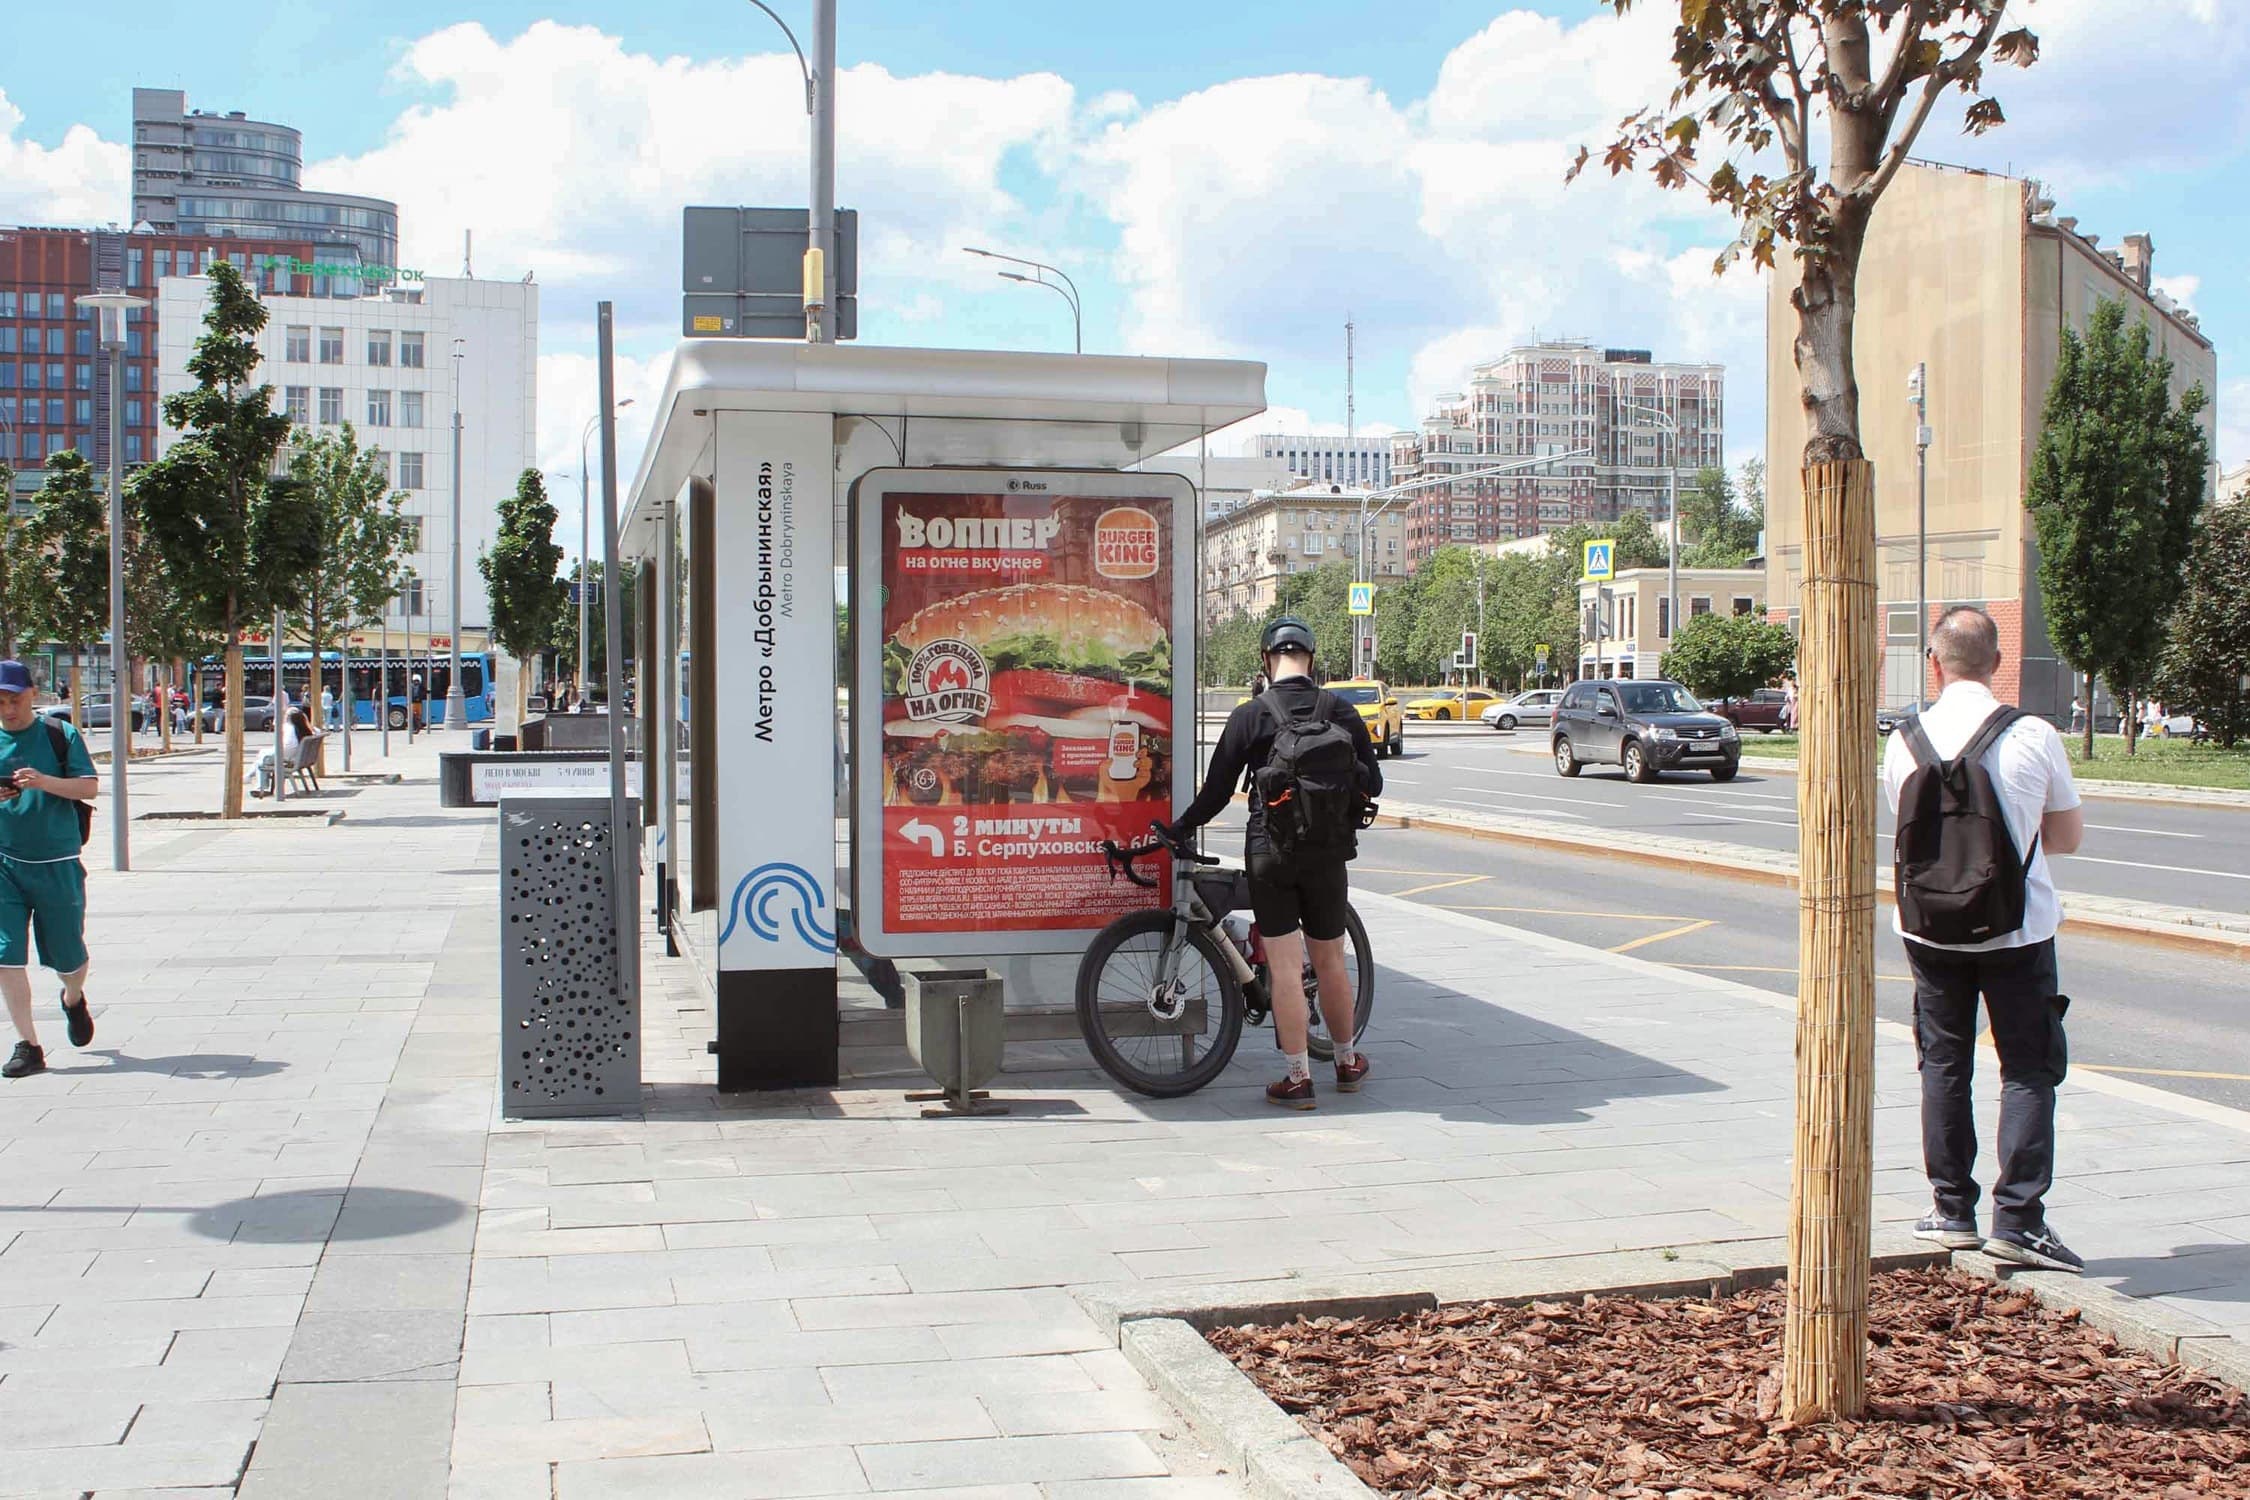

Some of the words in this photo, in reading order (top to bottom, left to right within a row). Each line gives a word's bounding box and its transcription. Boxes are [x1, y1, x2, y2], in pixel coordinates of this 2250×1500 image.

[1022, 480, 1047, 490] Russ
[779, 462, 796, 568] Dobryninskaya
[896, 504, 1061, 549] ВОППЕР
[1098, 530, 1155, 544] BURGER
[753, 461, 776, 658] «Добрынинская»
[905, 556, 926, 569] на
[929, 556, 969, 569] огне
[971, 556, 1043, 572] вкуснее
[1098, 544, 1156, 564] KING
[780, 572, 793, 618] Metro
[754, 665, 776, 743] Метро
[910, 698, 938, 717] НА
[939, 692, 987, 713] ОГНЕ
[1114, 744, 1135, 752] KING
[953, 815, 969, 836] 2
[974, 817, 1082, 840] минуты
[953, 840, 972, 857] Б.
